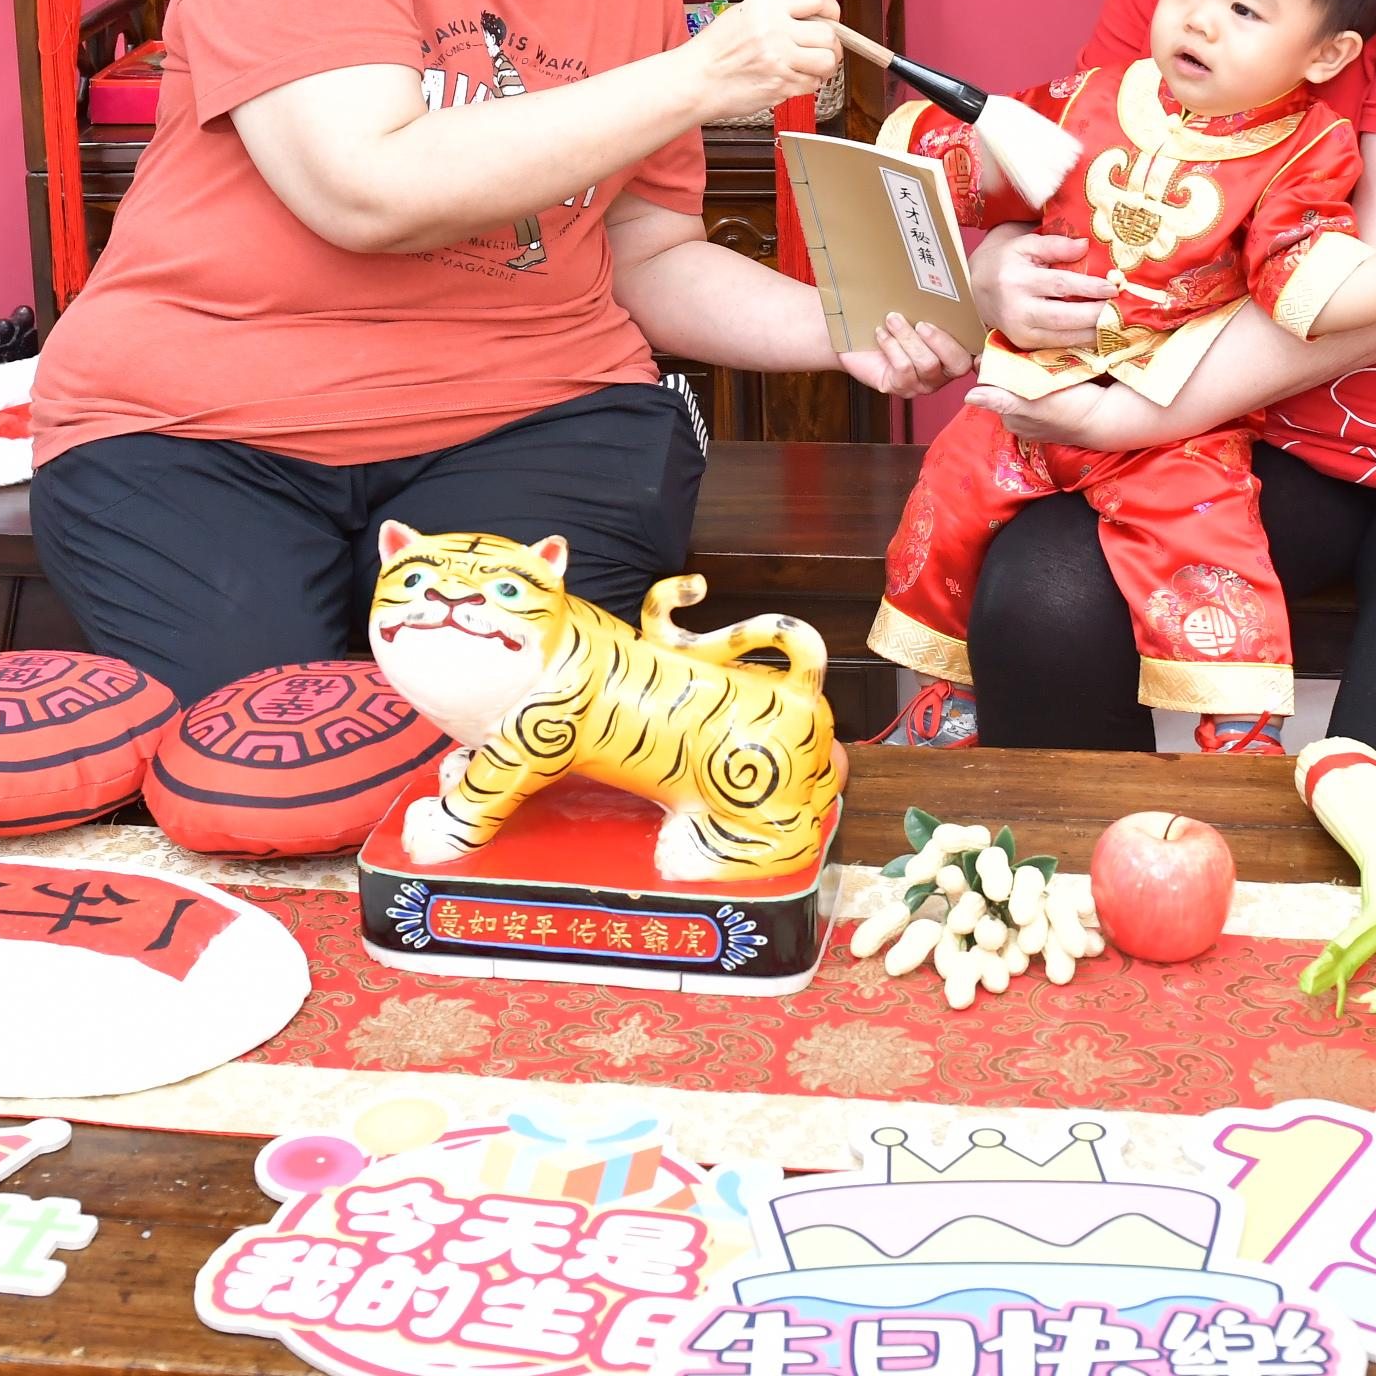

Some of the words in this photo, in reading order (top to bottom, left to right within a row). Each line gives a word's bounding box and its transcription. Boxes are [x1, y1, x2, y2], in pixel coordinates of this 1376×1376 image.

[508, 32, 528, 51] IS
[898, 186, 937, 267] 天才秘籍
[257, 677, 340, 719] 幸福
[347, 1182, 697, 1293] 今天是
